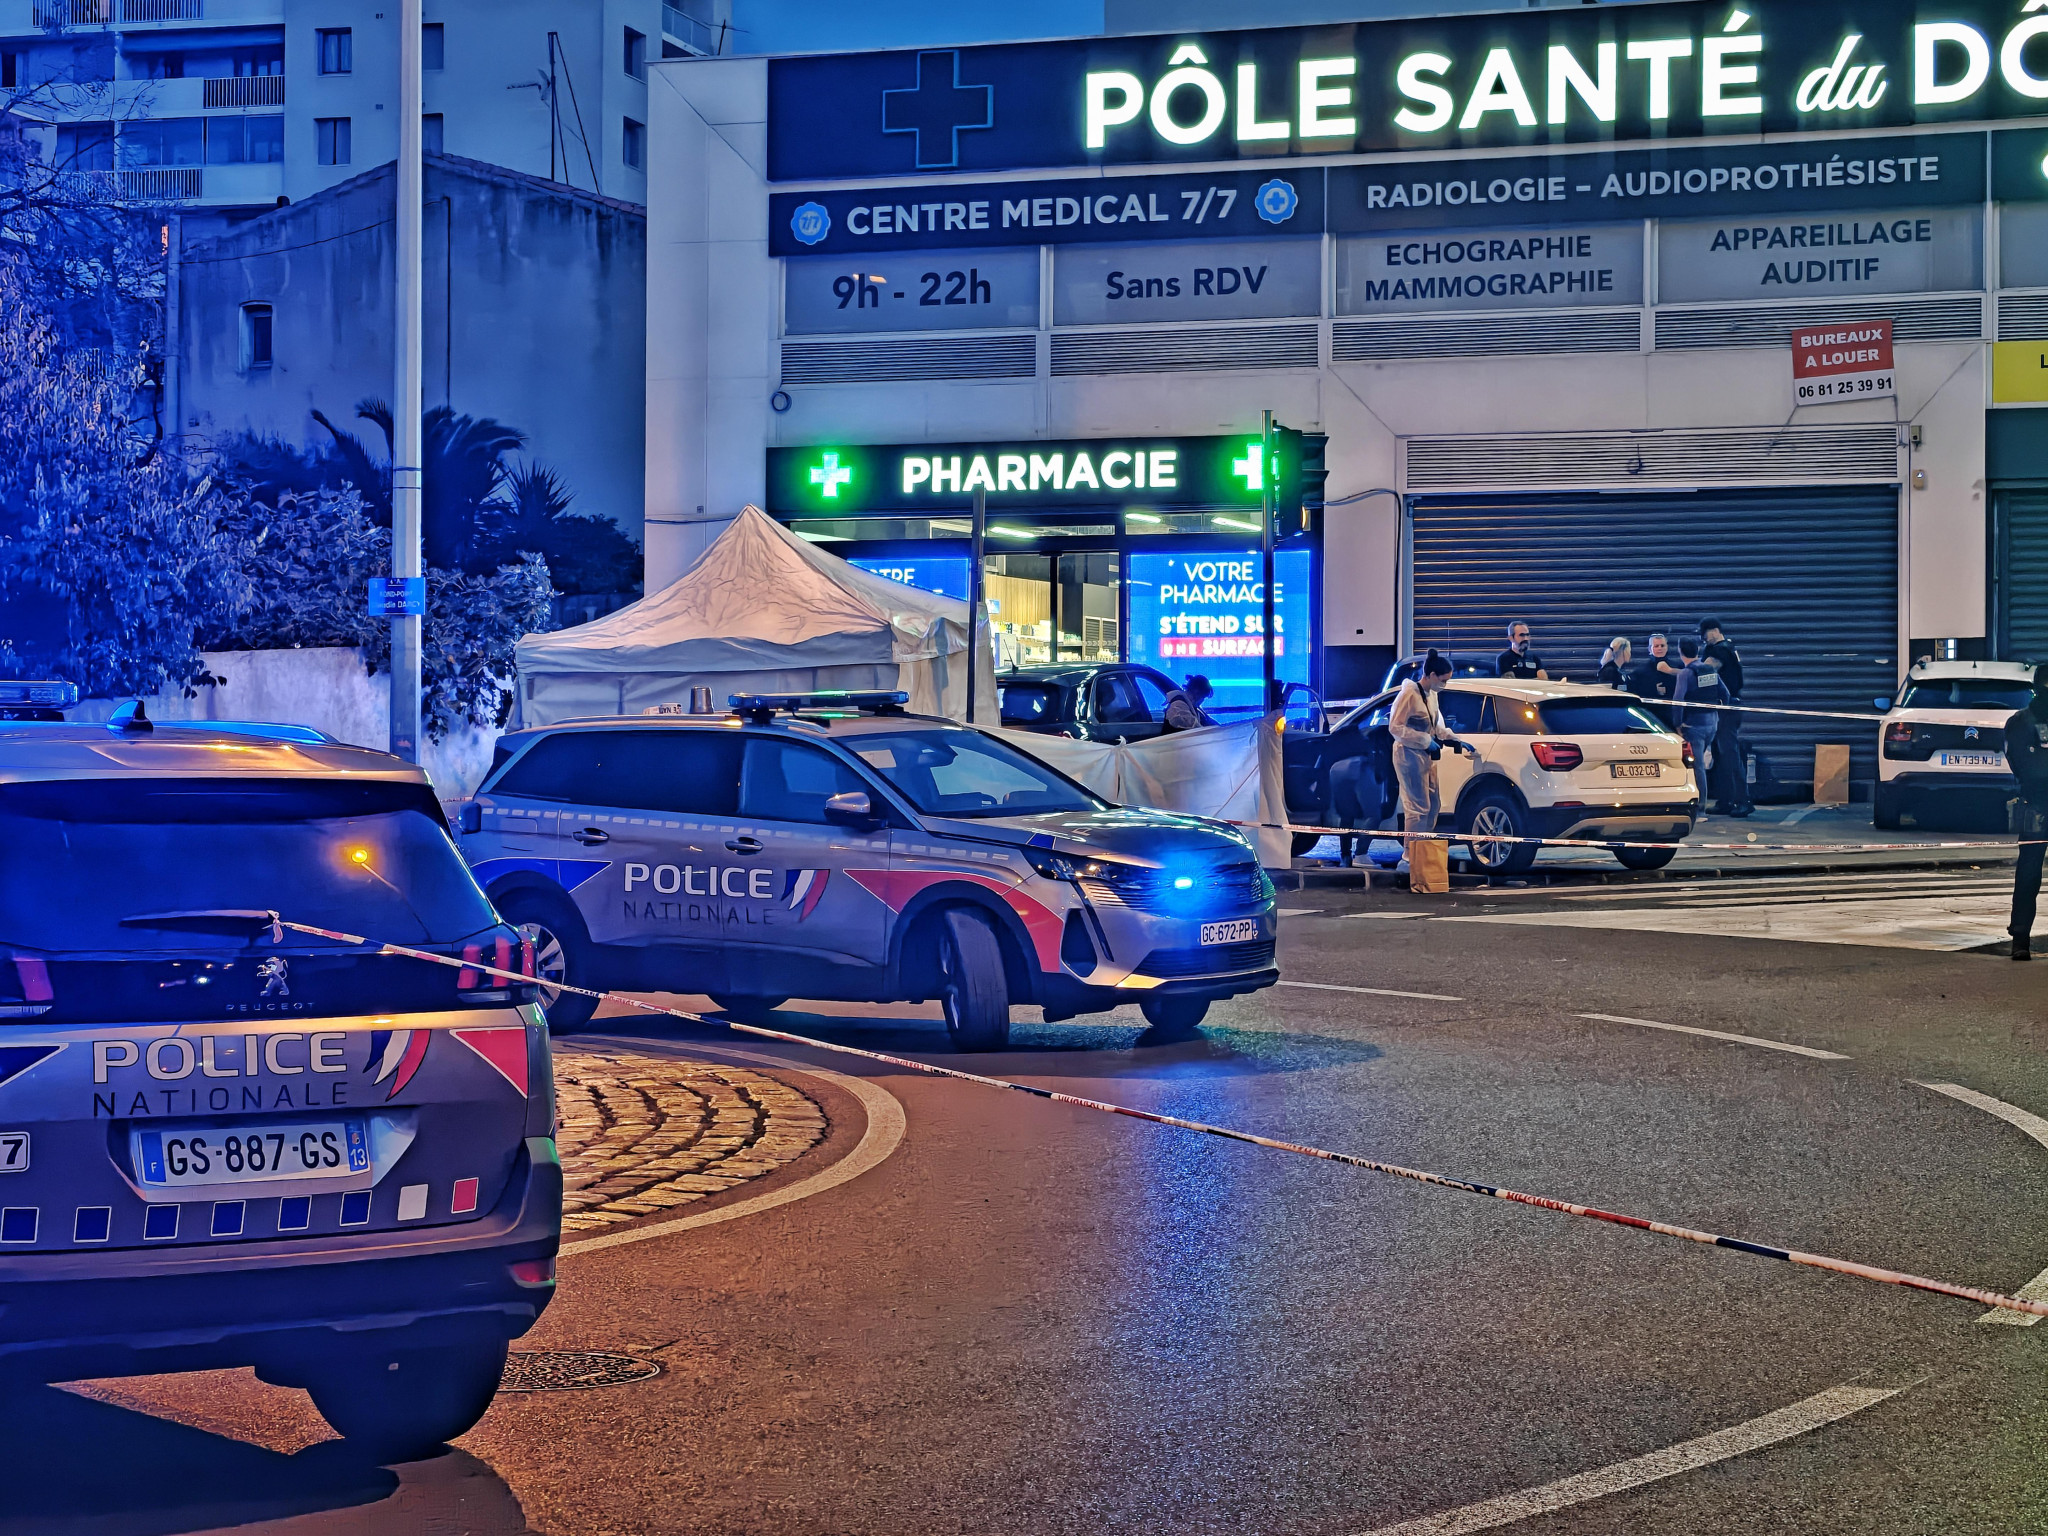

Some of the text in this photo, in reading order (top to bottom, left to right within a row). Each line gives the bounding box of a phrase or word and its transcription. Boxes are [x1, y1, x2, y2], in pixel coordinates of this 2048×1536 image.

[1085, 44, 1357, 148] PÔLE
[1393, 10, 1764, 133] SANTÉ
[1795, 33, 1887, 113] du
[1367, 176, 1566, 208] RADIOLOGIE
[1600, 154, 1939, 198] AUDIOPROTHÉSISTE
[846, 187, 1238, 235] CENTRE MEDICAL 7/7
[1386, 235, 1592, 266] ECHOGRAPHIE
[1709, 219, 1932, 251] APPAREILLAGE
[1106, 265, 1268, 301] Sans RDV
[1365, 269, 1613, 302] MAMMOGRAPHIE
[1760, 258, 1880, 285] AUDITIF
[832, 274, 880, 309] 9h
[920, 269, 992, 306] 22h
[1800, 329, 1883, 348] BUREAUX
[1805, 349, 1880, 368] A LOUER
[1799, 377, 1892, 398] 06 81 25 39 91
[902, 450, 1177, 494] PHARMACIE
[1184, 561, 1254, 582] VOTRE
[1160, 583, 1284, 604] PHARMACE
[1160, 611, 1240, 634] S'ÉTEND
[624, 862, 773, 899] POLICE
[623, 901, 775, 925] NATIONALE
[1202, 922, 1251, 942] GC-672-PP
[225, 1002, 316, 1011] PEUGEOT
[92, 1031, 348, 1084] POLICE
[93, 1082, 348, 1116] NATIONALE
[167, 1131, 341, 1176] GS-887-GS
[350, 1148, 367, 1166] 13
